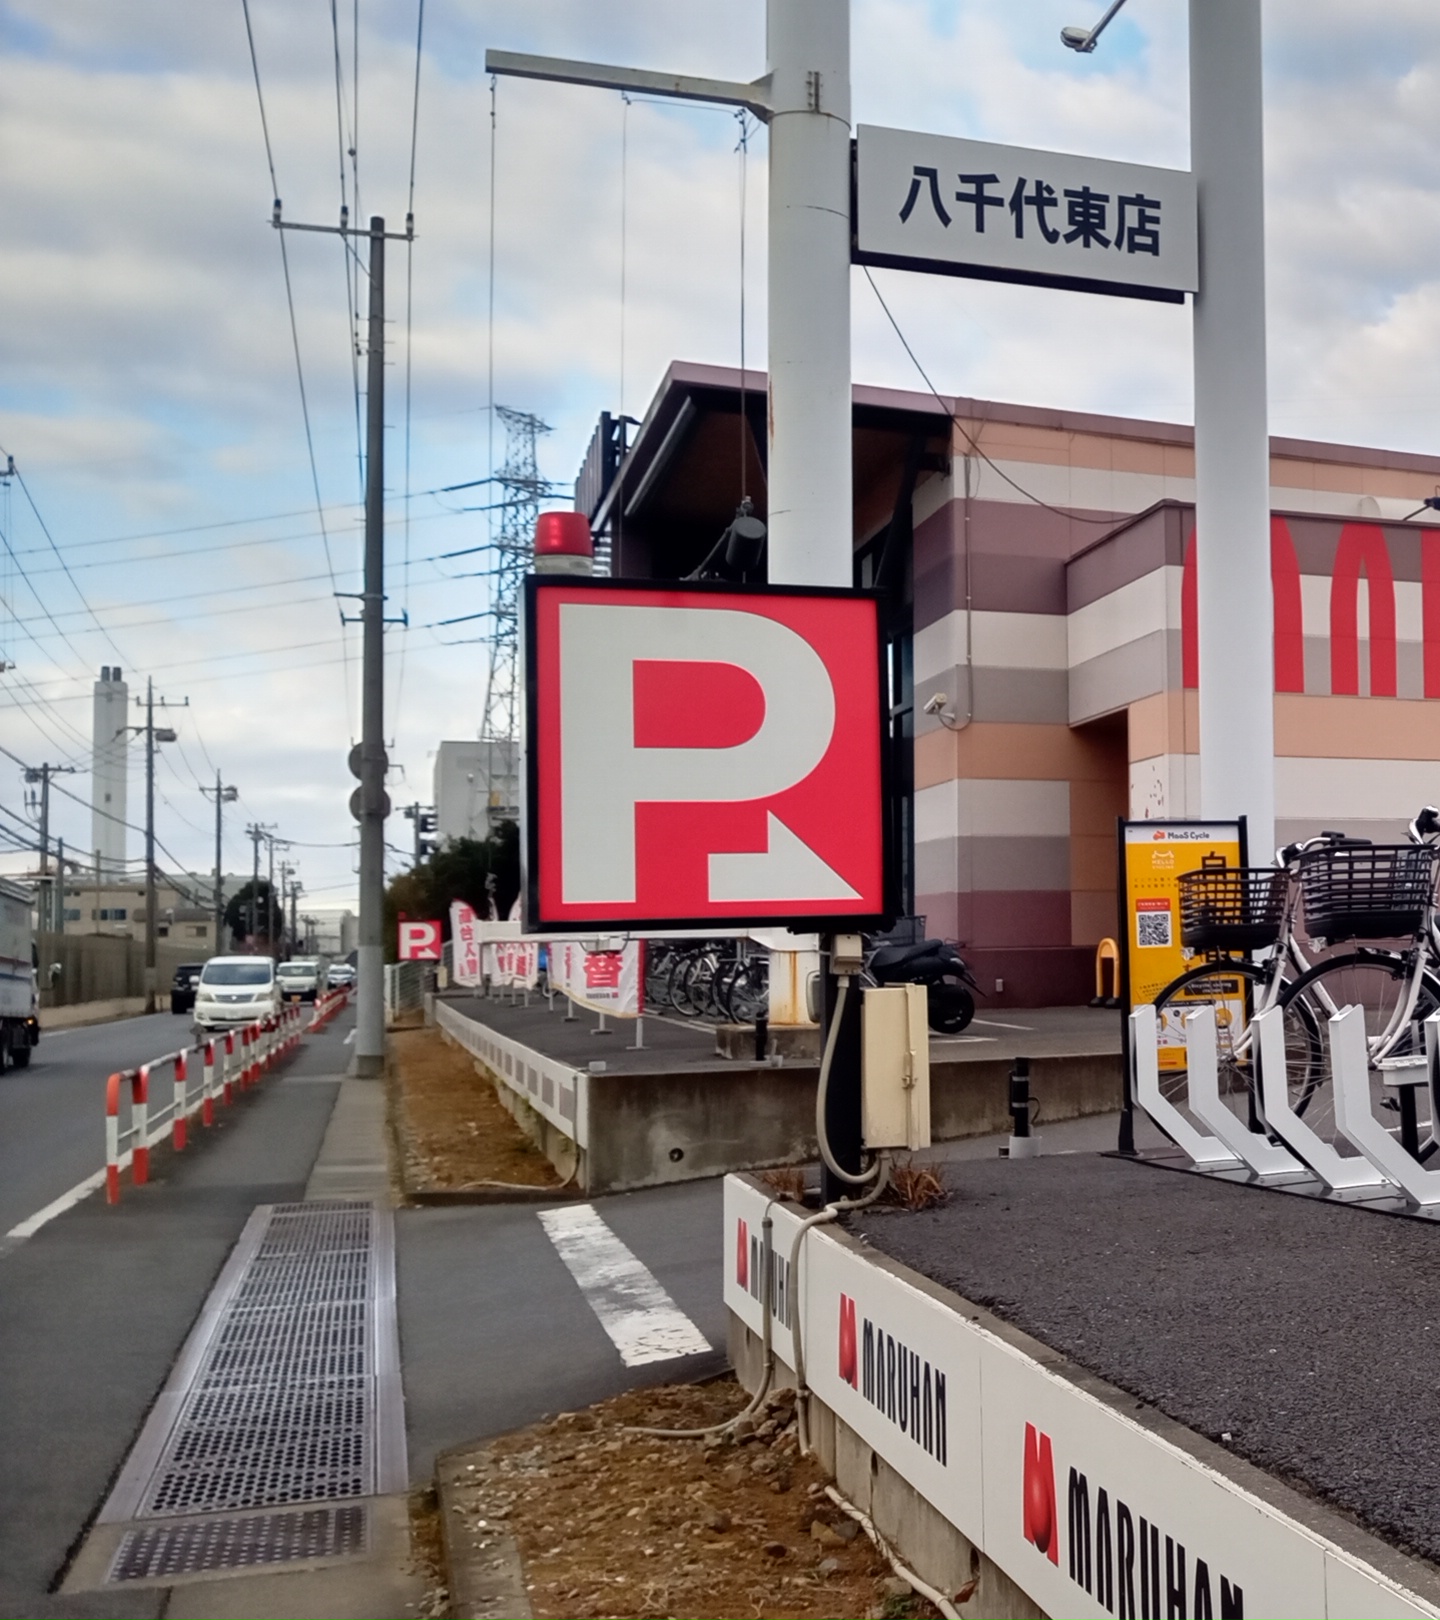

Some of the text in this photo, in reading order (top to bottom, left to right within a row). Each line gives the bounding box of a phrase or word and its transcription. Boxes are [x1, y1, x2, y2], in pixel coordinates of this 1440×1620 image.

[899, 166, 1162, 257] 八千代東店
[559, 603, 837, 904] P
[1167, 831, 1210, 840] MaaS Cycle
[400, 922, 436, 959] P
[863, 1317, 947, 1467] MARUHAN
